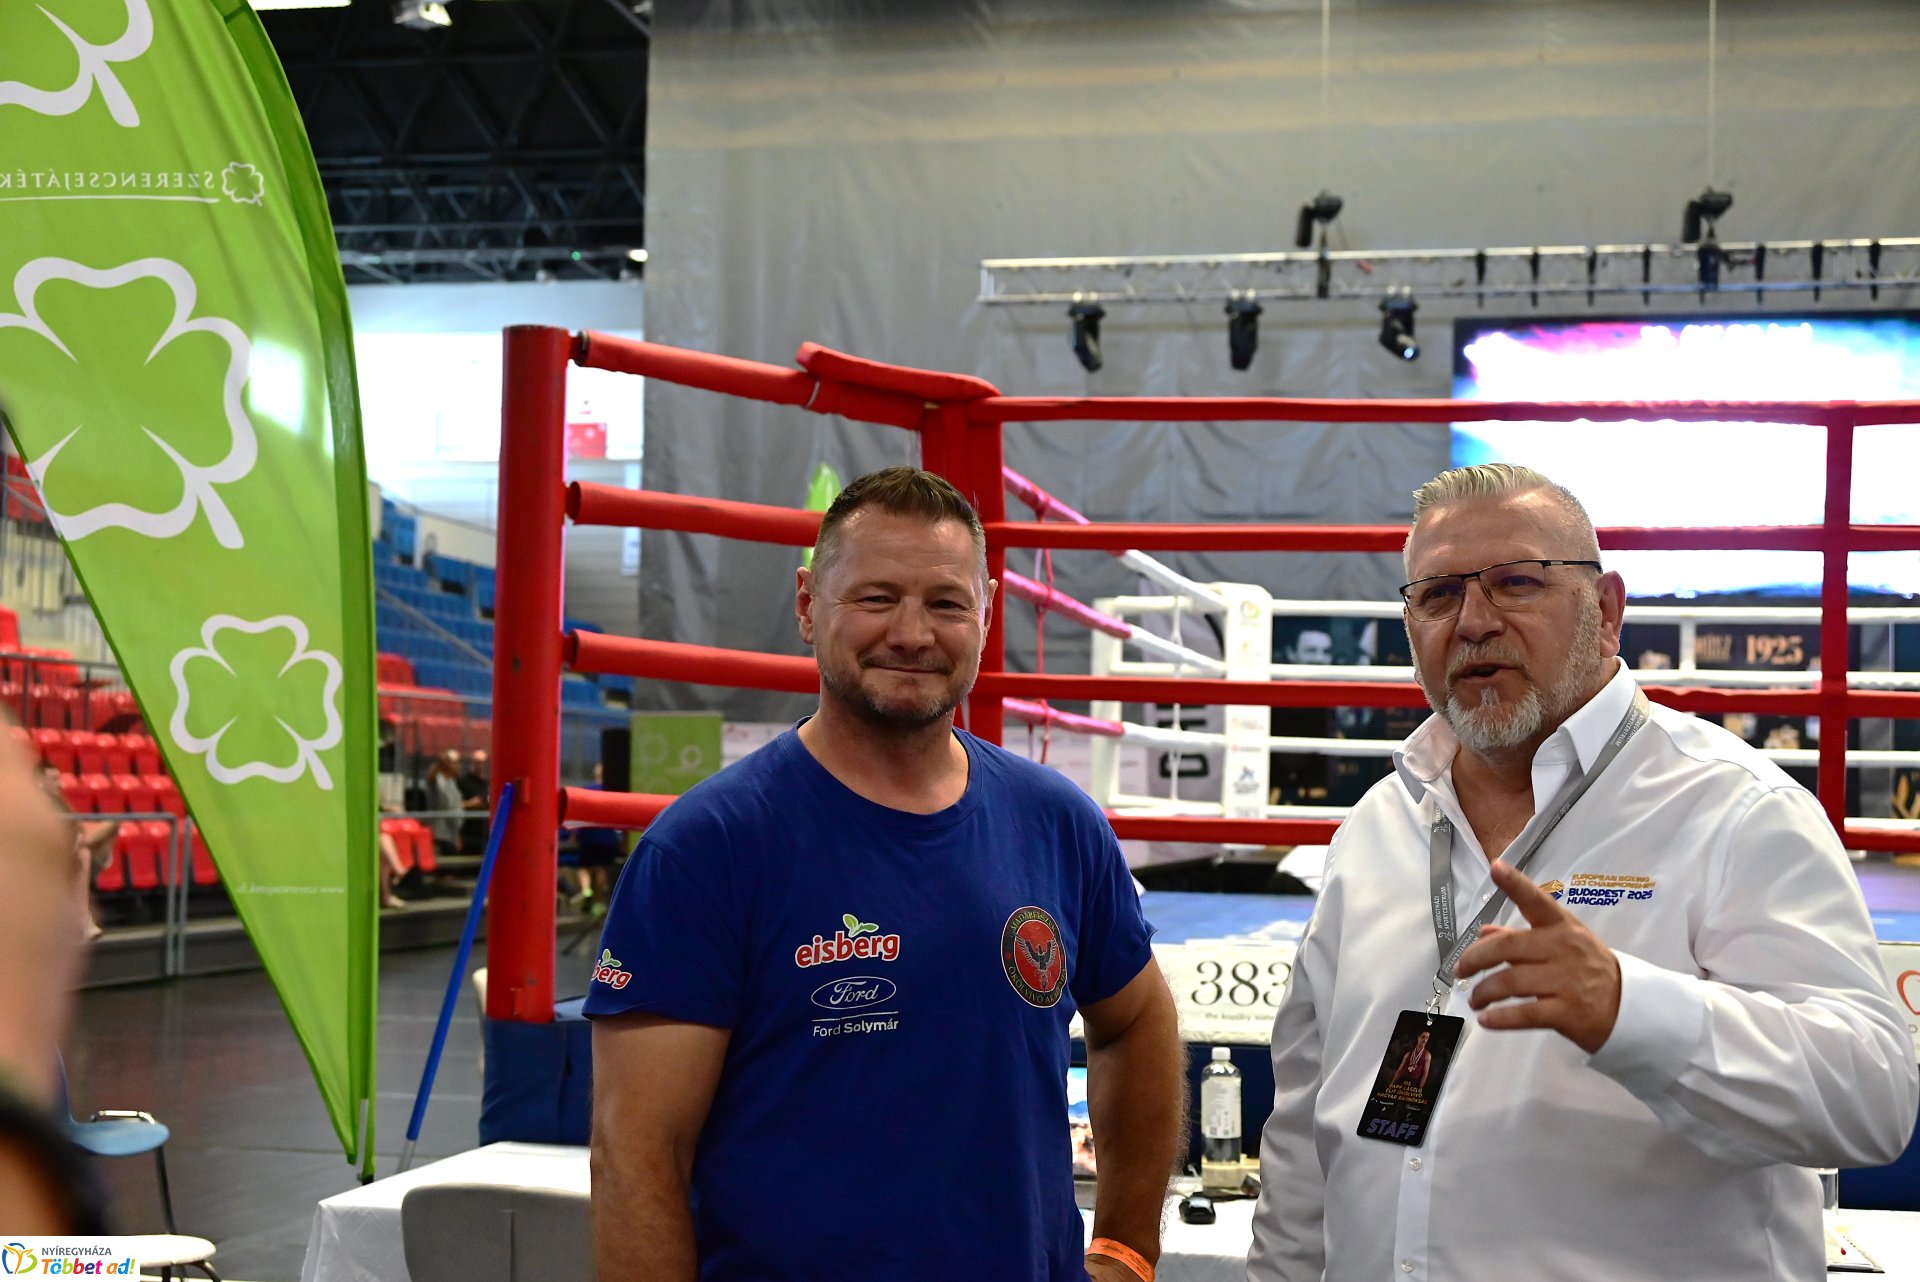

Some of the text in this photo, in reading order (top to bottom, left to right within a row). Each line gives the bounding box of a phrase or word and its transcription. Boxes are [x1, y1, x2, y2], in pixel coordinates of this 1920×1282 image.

[1746, 634, 1804, 665] 1925
[1566, 897, 1619, 907] HUNGARY
[1568, 888, 1654, 900] BUDAPEST 2025
[1440, 886, 1449, 930] SPORTCENTRUM
[795, 930, 900, 968] eisberg
[829, 980, 880, 1005] Ford
[1191, 960, 1292, 1007] 383
[812, 1018, 899, 1037] Ford Solymár
[1366, 1118, 1419, 1140] STAFF
